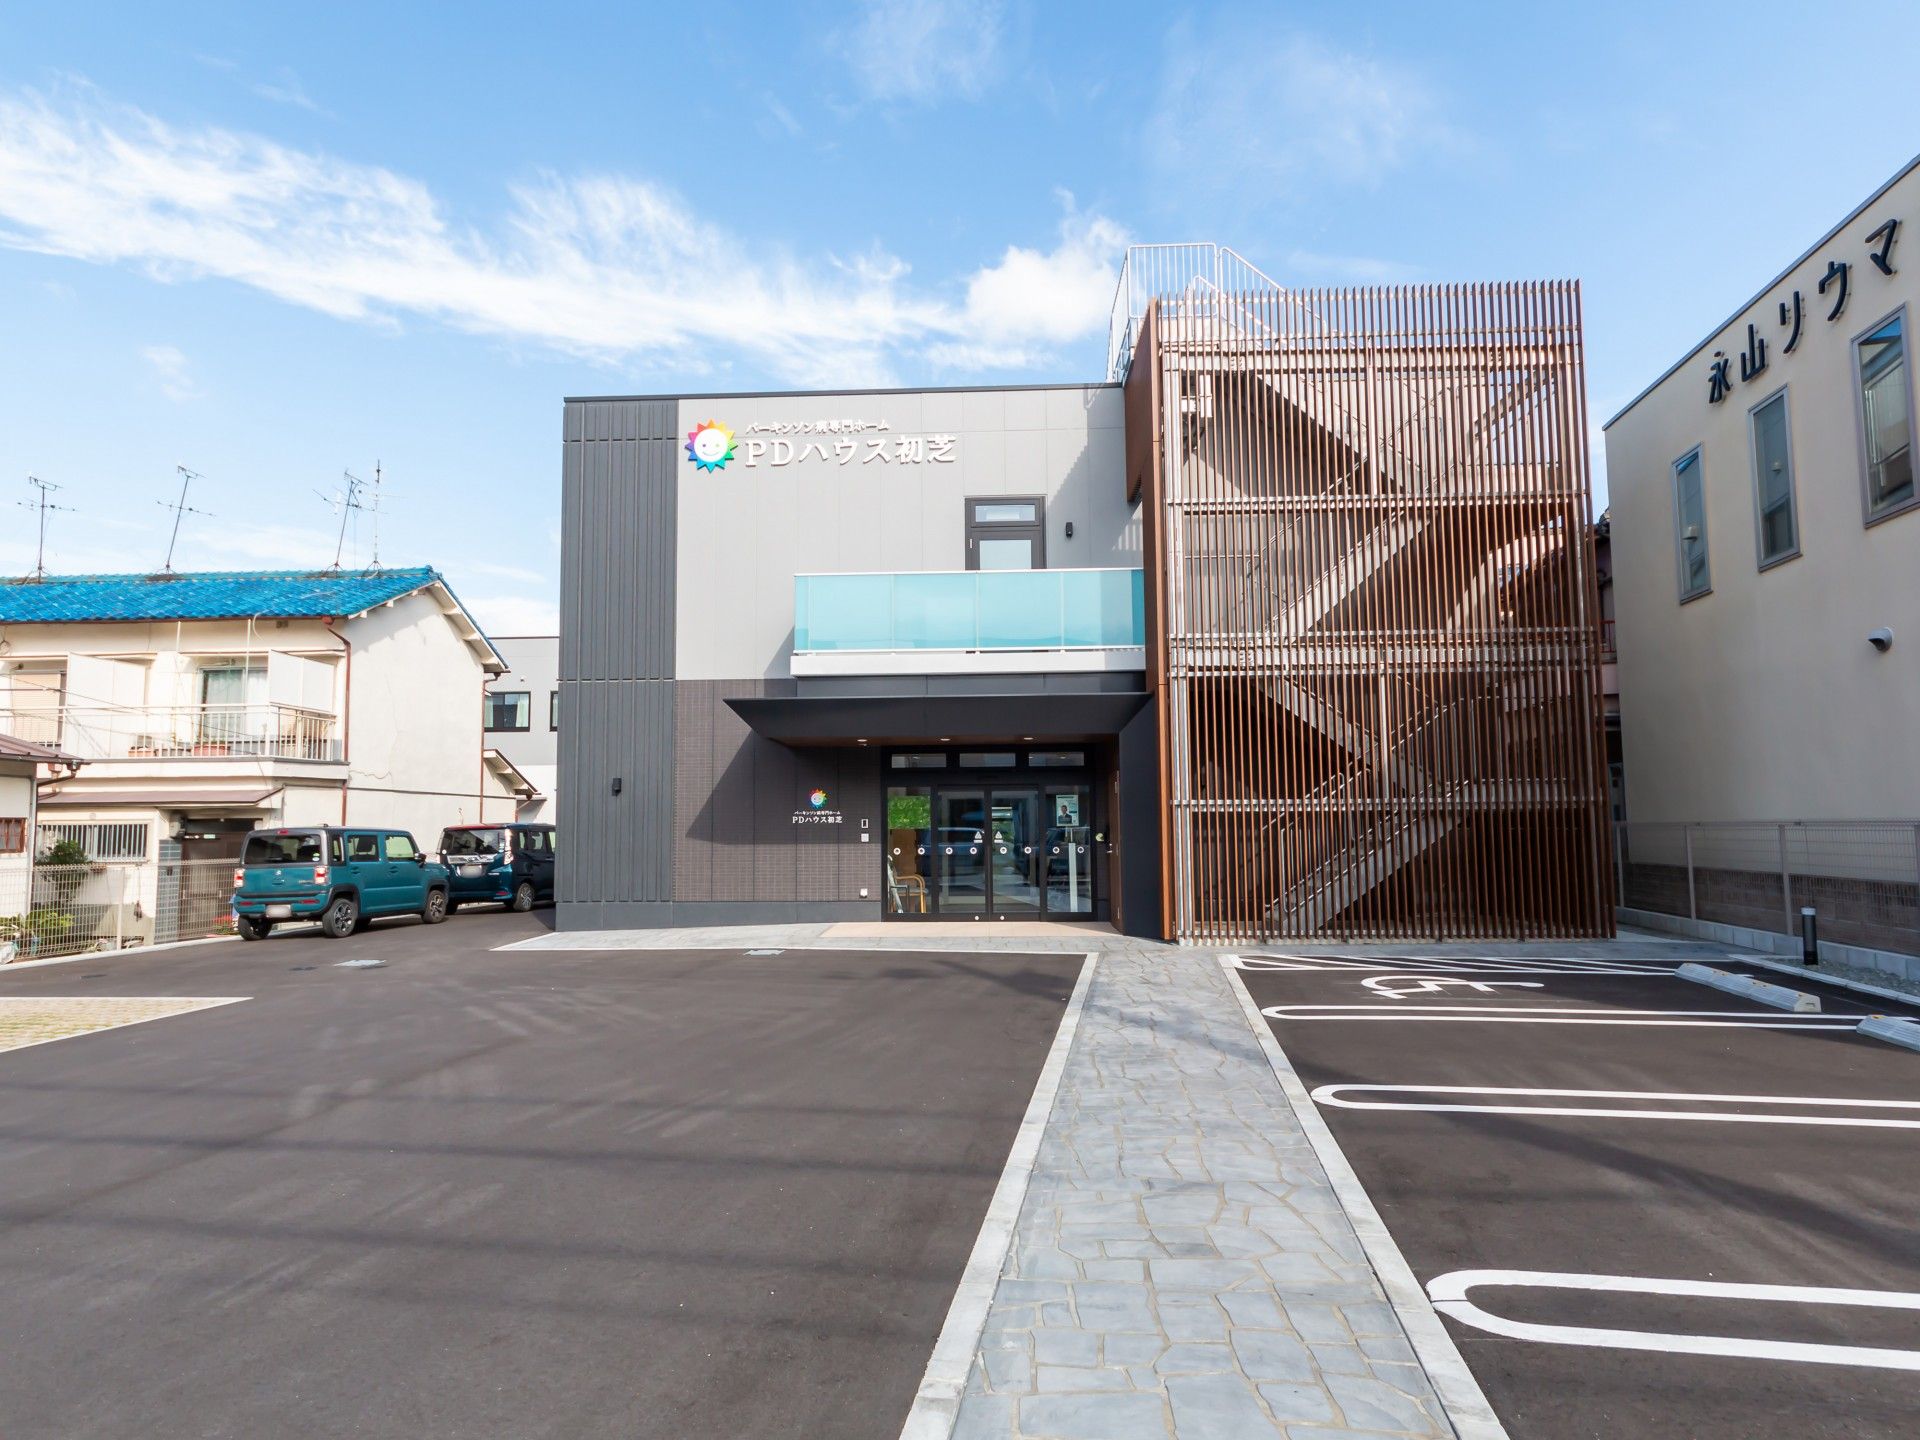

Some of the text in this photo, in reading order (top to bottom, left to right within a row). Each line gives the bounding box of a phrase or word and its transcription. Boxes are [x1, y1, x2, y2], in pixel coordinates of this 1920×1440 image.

[1708, 218, 1898, 404] 永山リウマ
[745, 420, 890, 435] パーキンソン病専門ホーム
[745, 435, 957, 467] PDハウス初芝
[792, 815, 843, 824] PDハウス初芝
